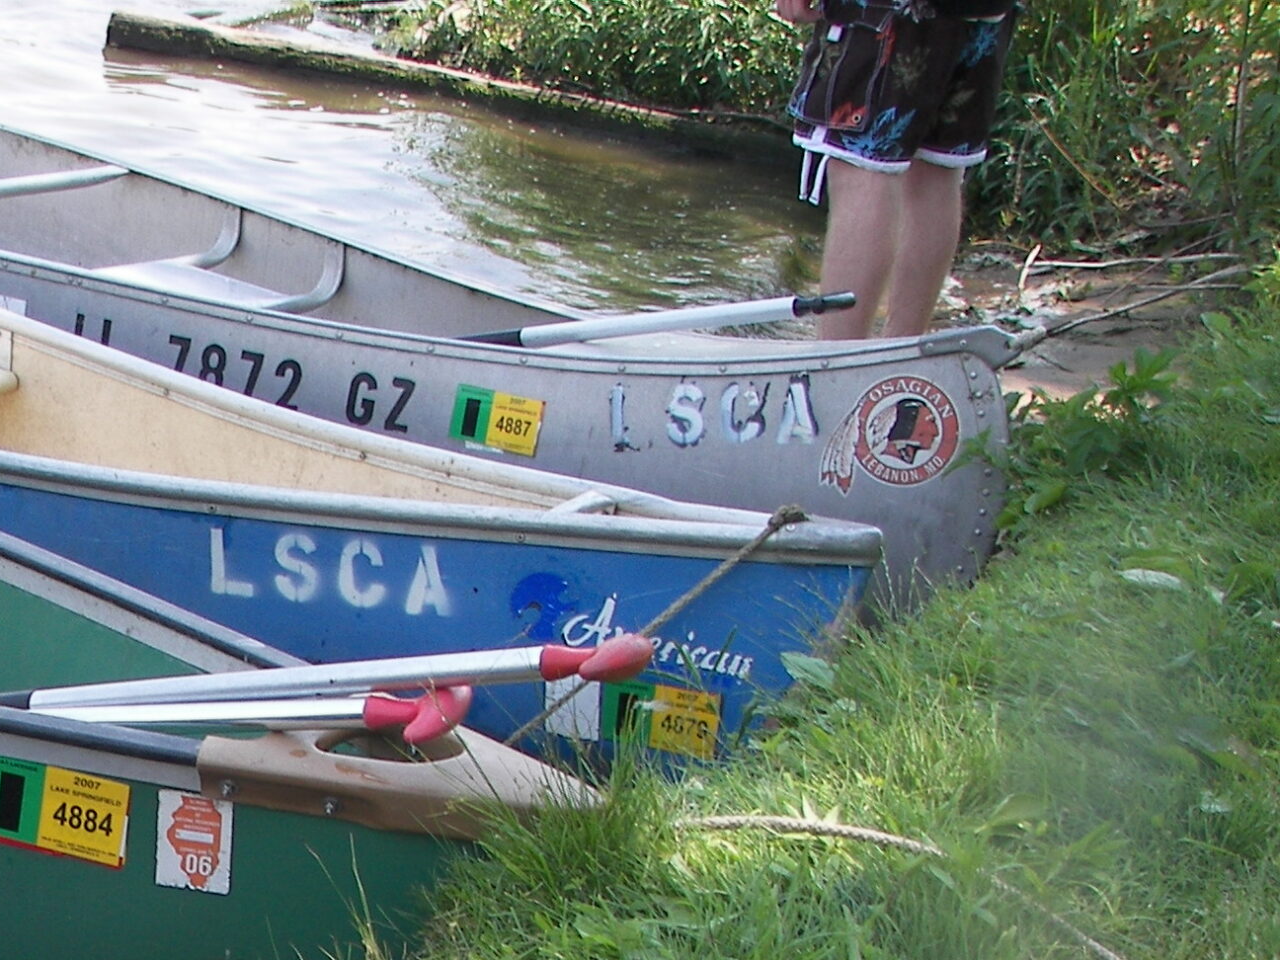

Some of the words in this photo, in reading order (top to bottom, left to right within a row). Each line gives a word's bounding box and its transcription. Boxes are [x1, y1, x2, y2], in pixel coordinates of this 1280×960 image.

[169, 334, 303, 411] 7872
[345, 371, 417, 434] GZ
[869, 378, 954, 419] OSAGIAN
[495, 415, 532, 438] 4887
[861, 453, 919, 483] LEBANON
[49, 785, 71, 795] LAKE
[73, 775, 102, 790] 2007
[52, 802, 113, 837] 4884
[185, 853, 213, 876] 06
